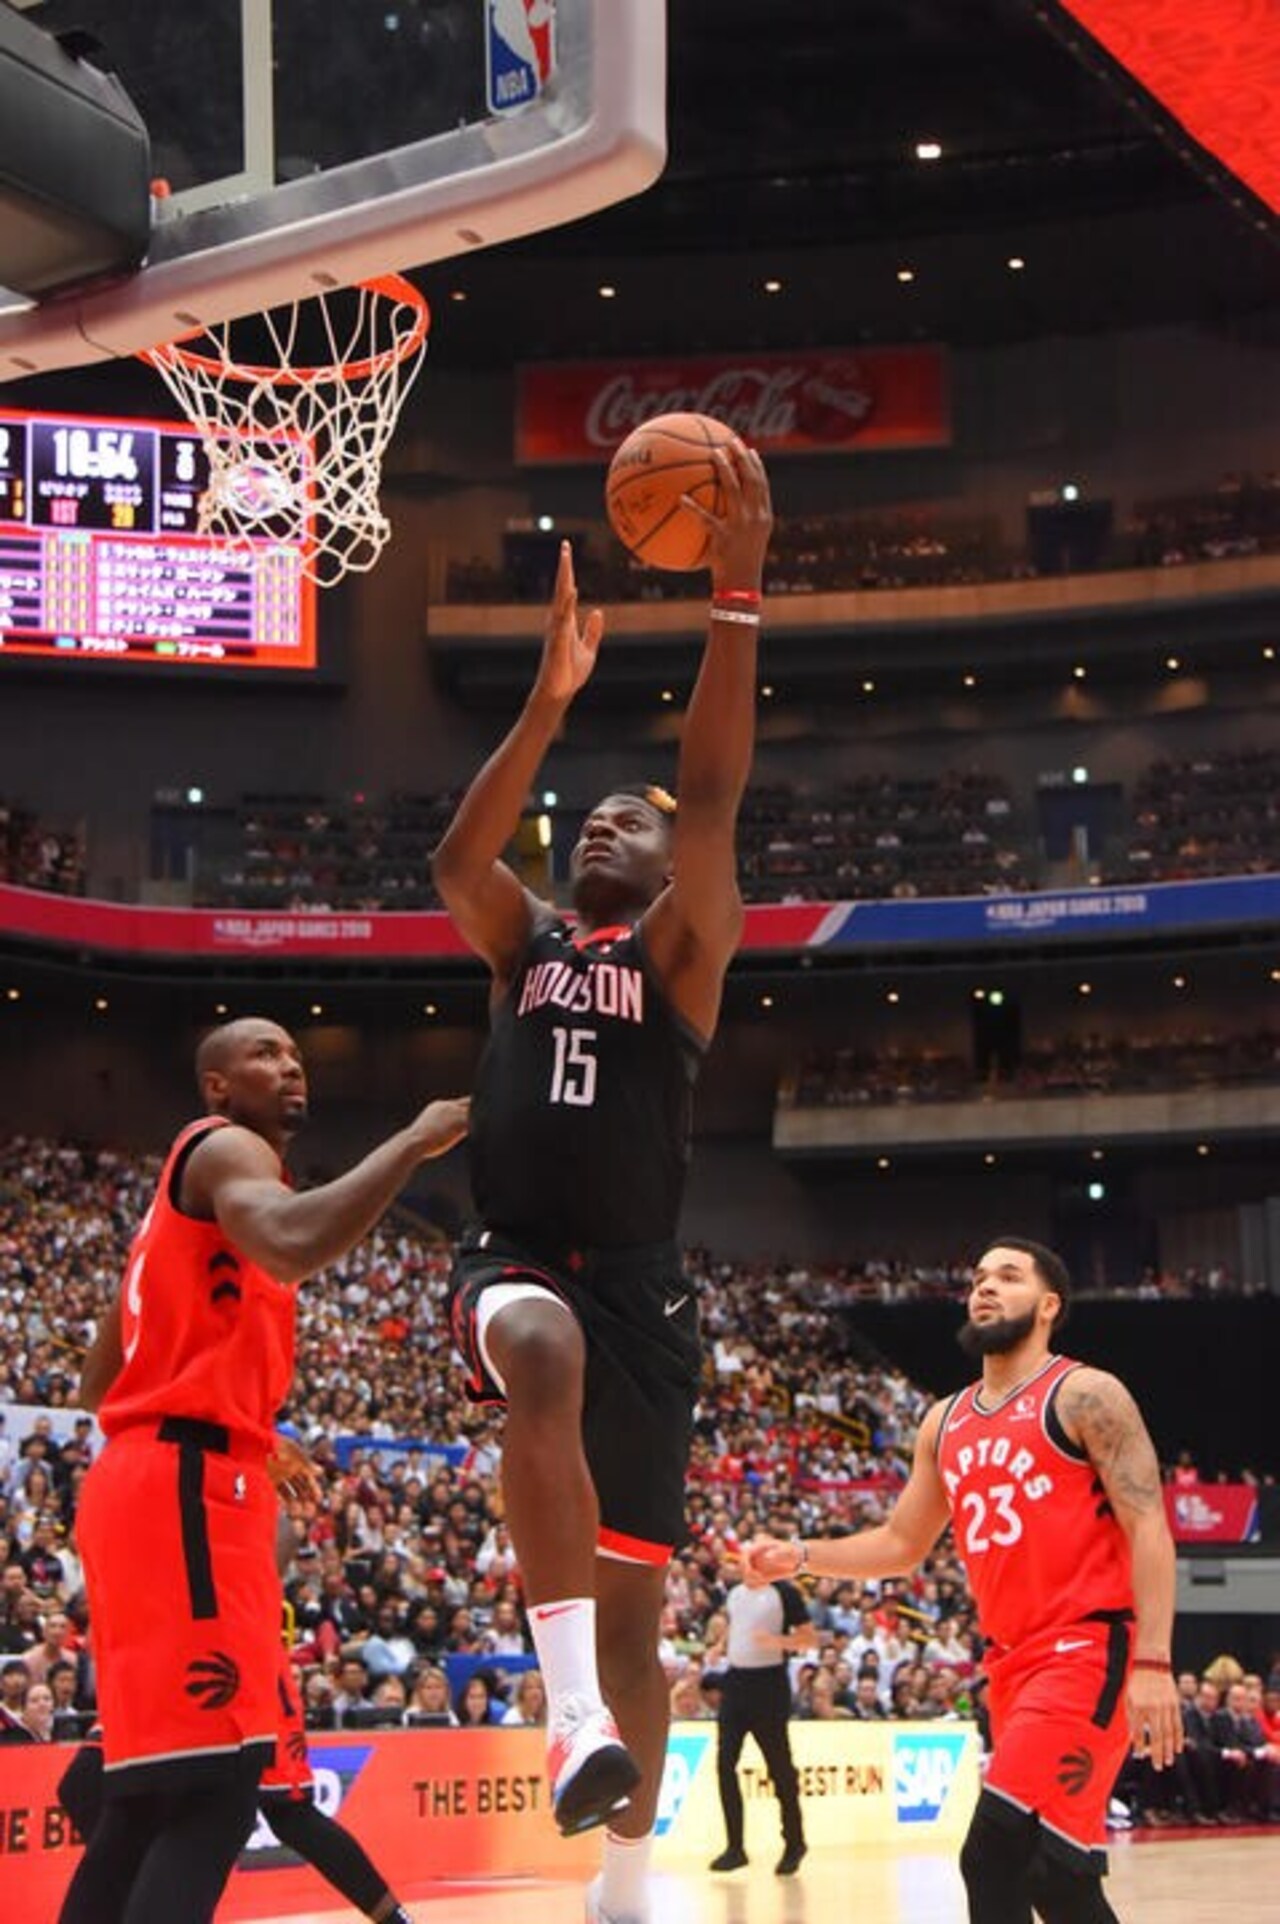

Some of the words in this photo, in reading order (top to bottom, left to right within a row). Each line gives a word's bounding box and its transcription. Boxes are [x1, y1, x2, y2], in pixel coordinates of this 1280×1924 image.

[496, 67, 528, 102] NBA
[585, 367, 804, 447] CocaCola
[517, 961, 643, 1024] HOUSON
[550, 1027, 597, 1107] 15
[943, 1437, 1053, 1501] APTORS
[961, 1484, 1023, 1553] 23
[414, 1779, 467, 1818] THE
[476, 1776, 542, 1813] BEST
[799, 1765, 838, 1797] EST
[845, 1764, 883, 1796] RUN
[893, 1747, 955, 1807] SAP
